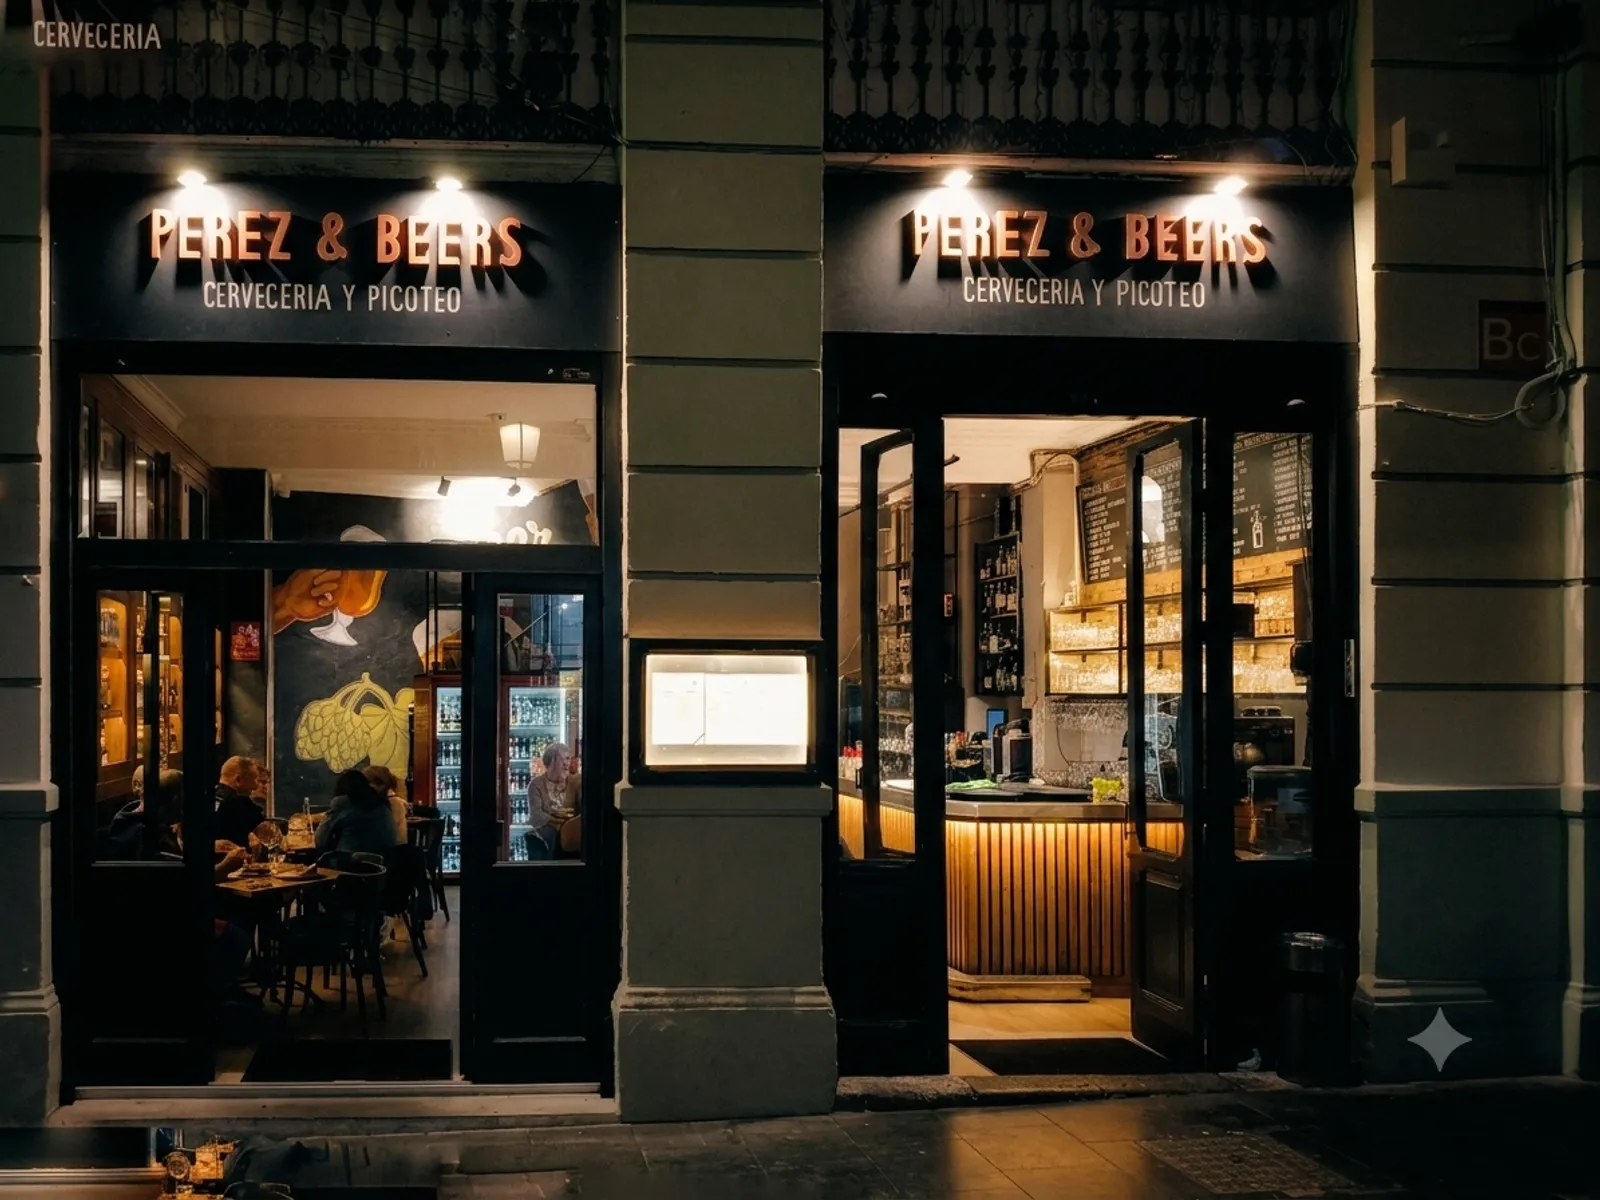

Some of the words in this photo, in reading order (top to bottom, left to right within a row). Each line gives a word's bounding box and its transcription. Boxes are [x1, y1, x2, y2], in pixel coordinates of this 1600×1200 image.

[33, 20, 161, 50] CERVECERIA
[150, 208, 292, 261] PEREZ
[318, 213, 348, 261] &
[377, 214, 523, 268] BEERS
[914, 211, 1050, 258] PEREZ
[1071, 213, 1101, 259] &
[1125, 214, 1267, 264] BEERS
[203, 281, 332, 311] CERVECERIA
[342, 284, 355, 311] Y
[367, 284, 461, 314] PICOTEO
[963, 276, 1084, 305] CERVECERIA
[1092, 279, 1105, 306] Y
[1116, 279, 1206, 309] PICOTEO
[1482, 317, 1541, 361] Bc
